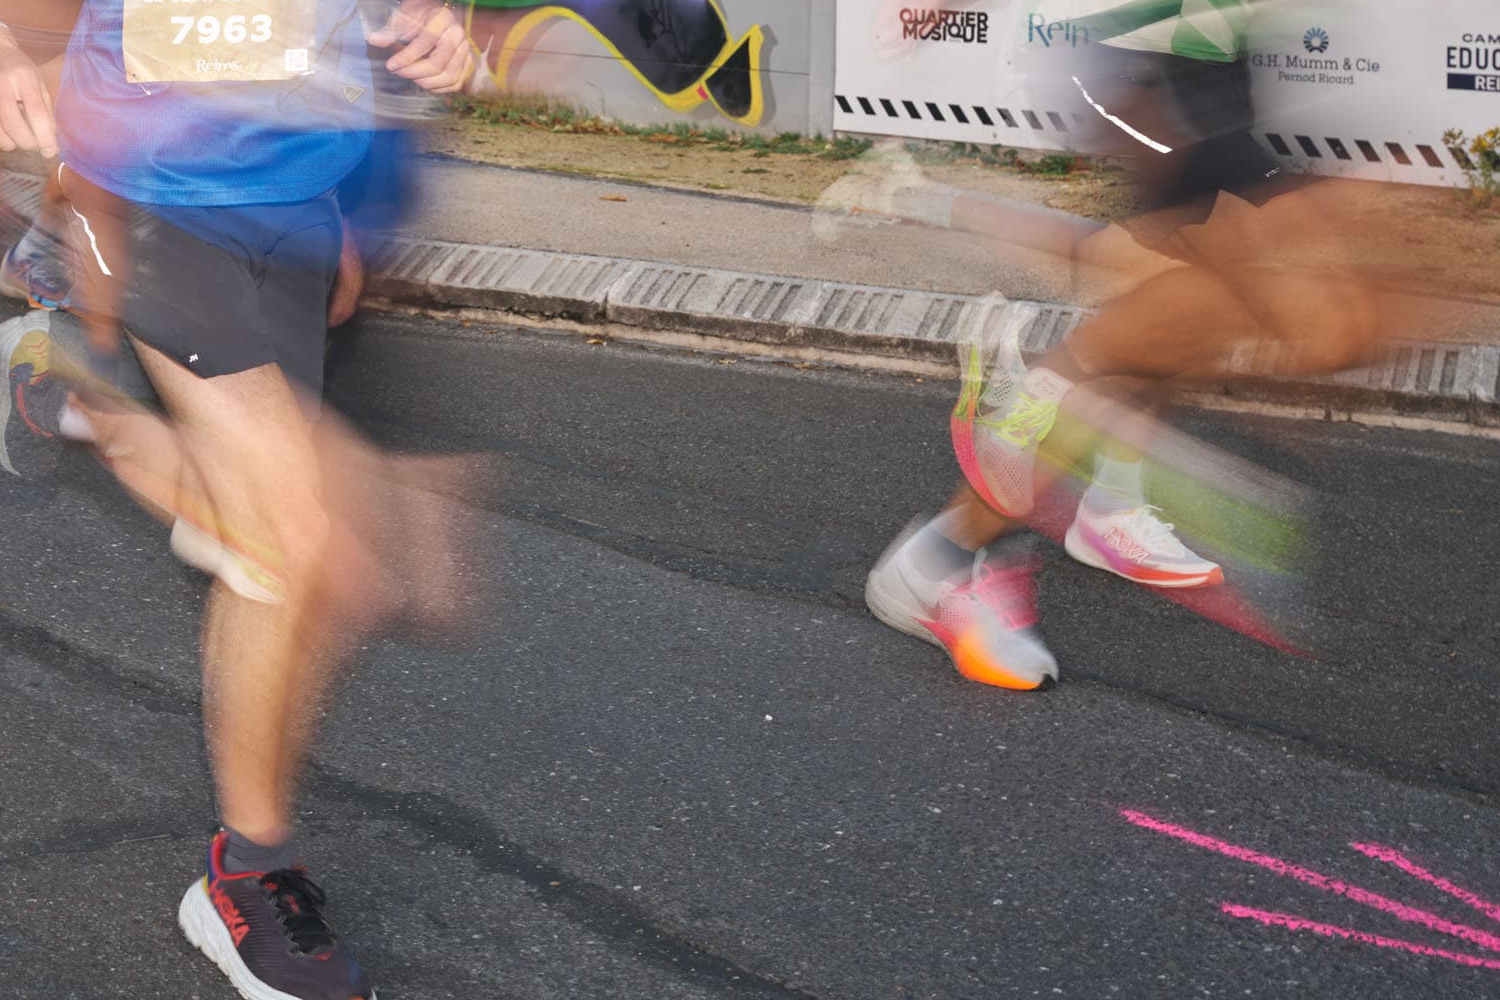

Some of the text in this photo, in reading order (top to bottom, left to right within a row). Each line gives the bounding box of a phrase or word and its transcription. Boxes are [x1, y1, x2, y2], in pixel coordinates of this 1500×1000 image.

[170, 14, 272, 45] 7963
[903, 21, 989, 43] MUSIQUE
[1028, 13, 1093, 48] Reim
[1252, 54, 1380, 72] G.H. Mumm & Cie
[1278, 71, 1354, 85] Pernod Ricard
